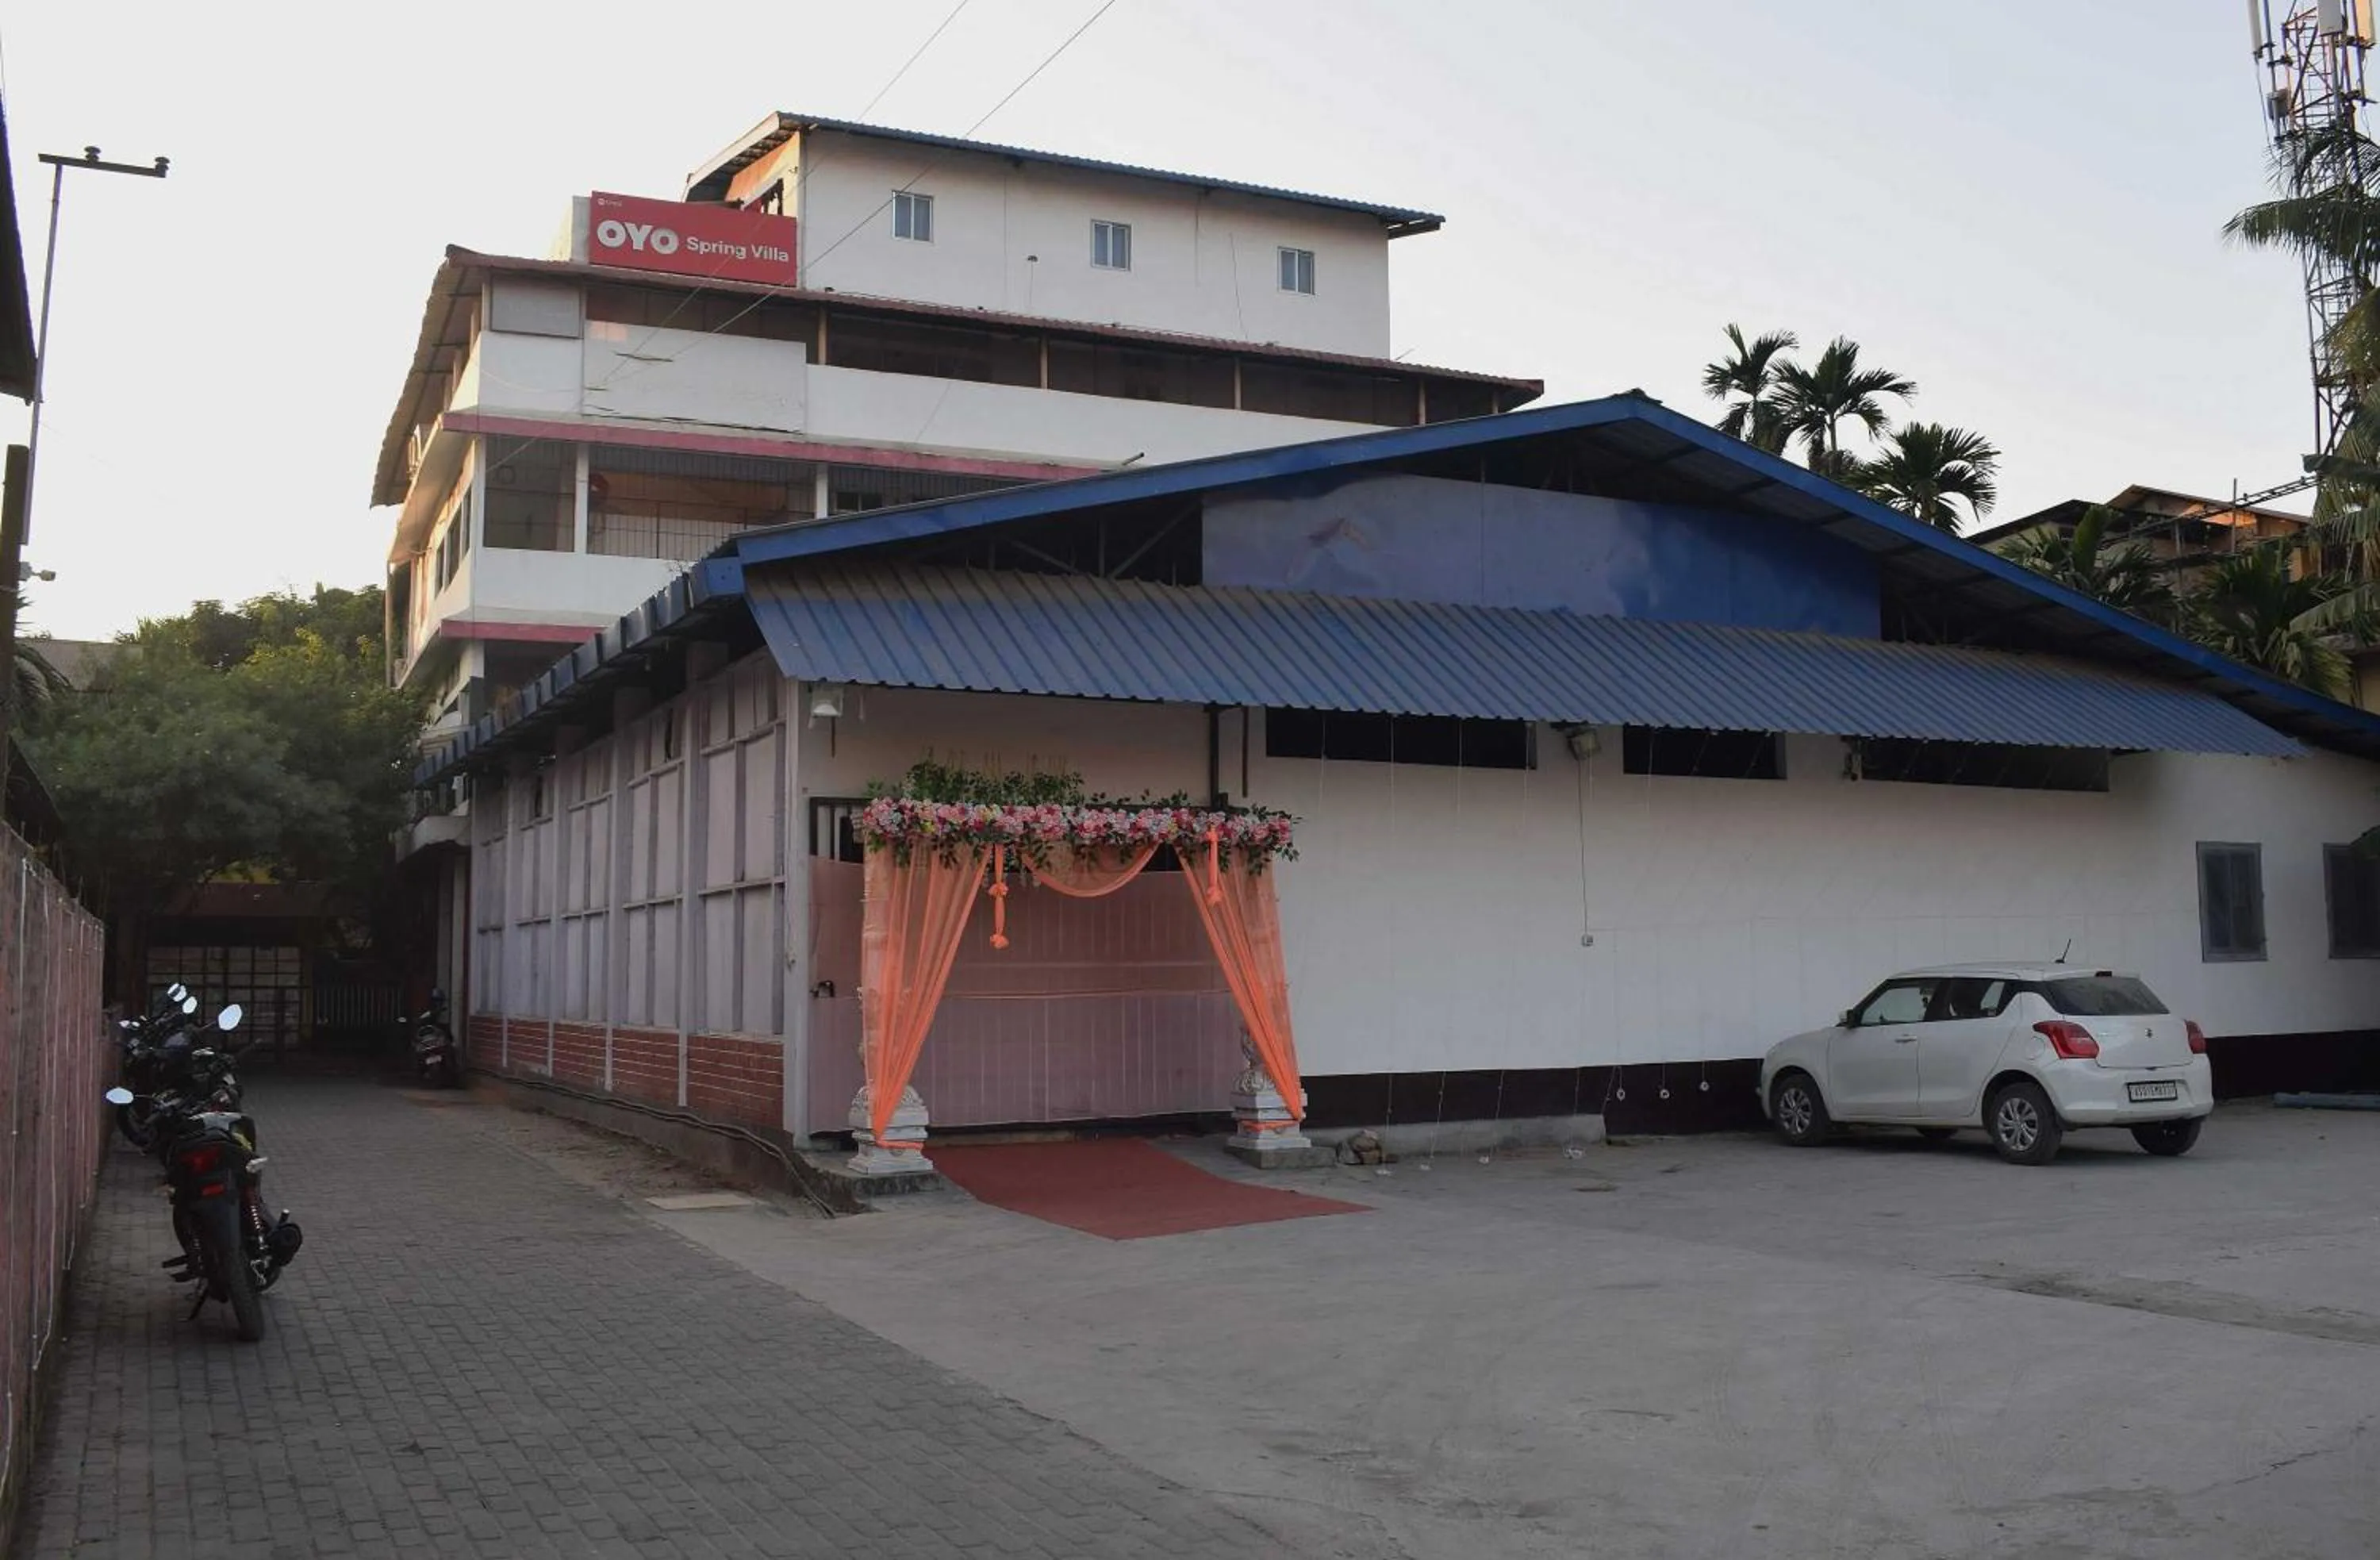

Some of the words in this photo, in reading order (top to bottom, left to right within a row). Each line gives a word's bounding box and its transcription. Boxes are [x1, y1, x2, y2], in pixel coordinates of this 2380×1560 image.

[597, 220, 679, 255] OYO
[686, 236, 747, 259] Spring
[751, 244, 789, 263] Villa
